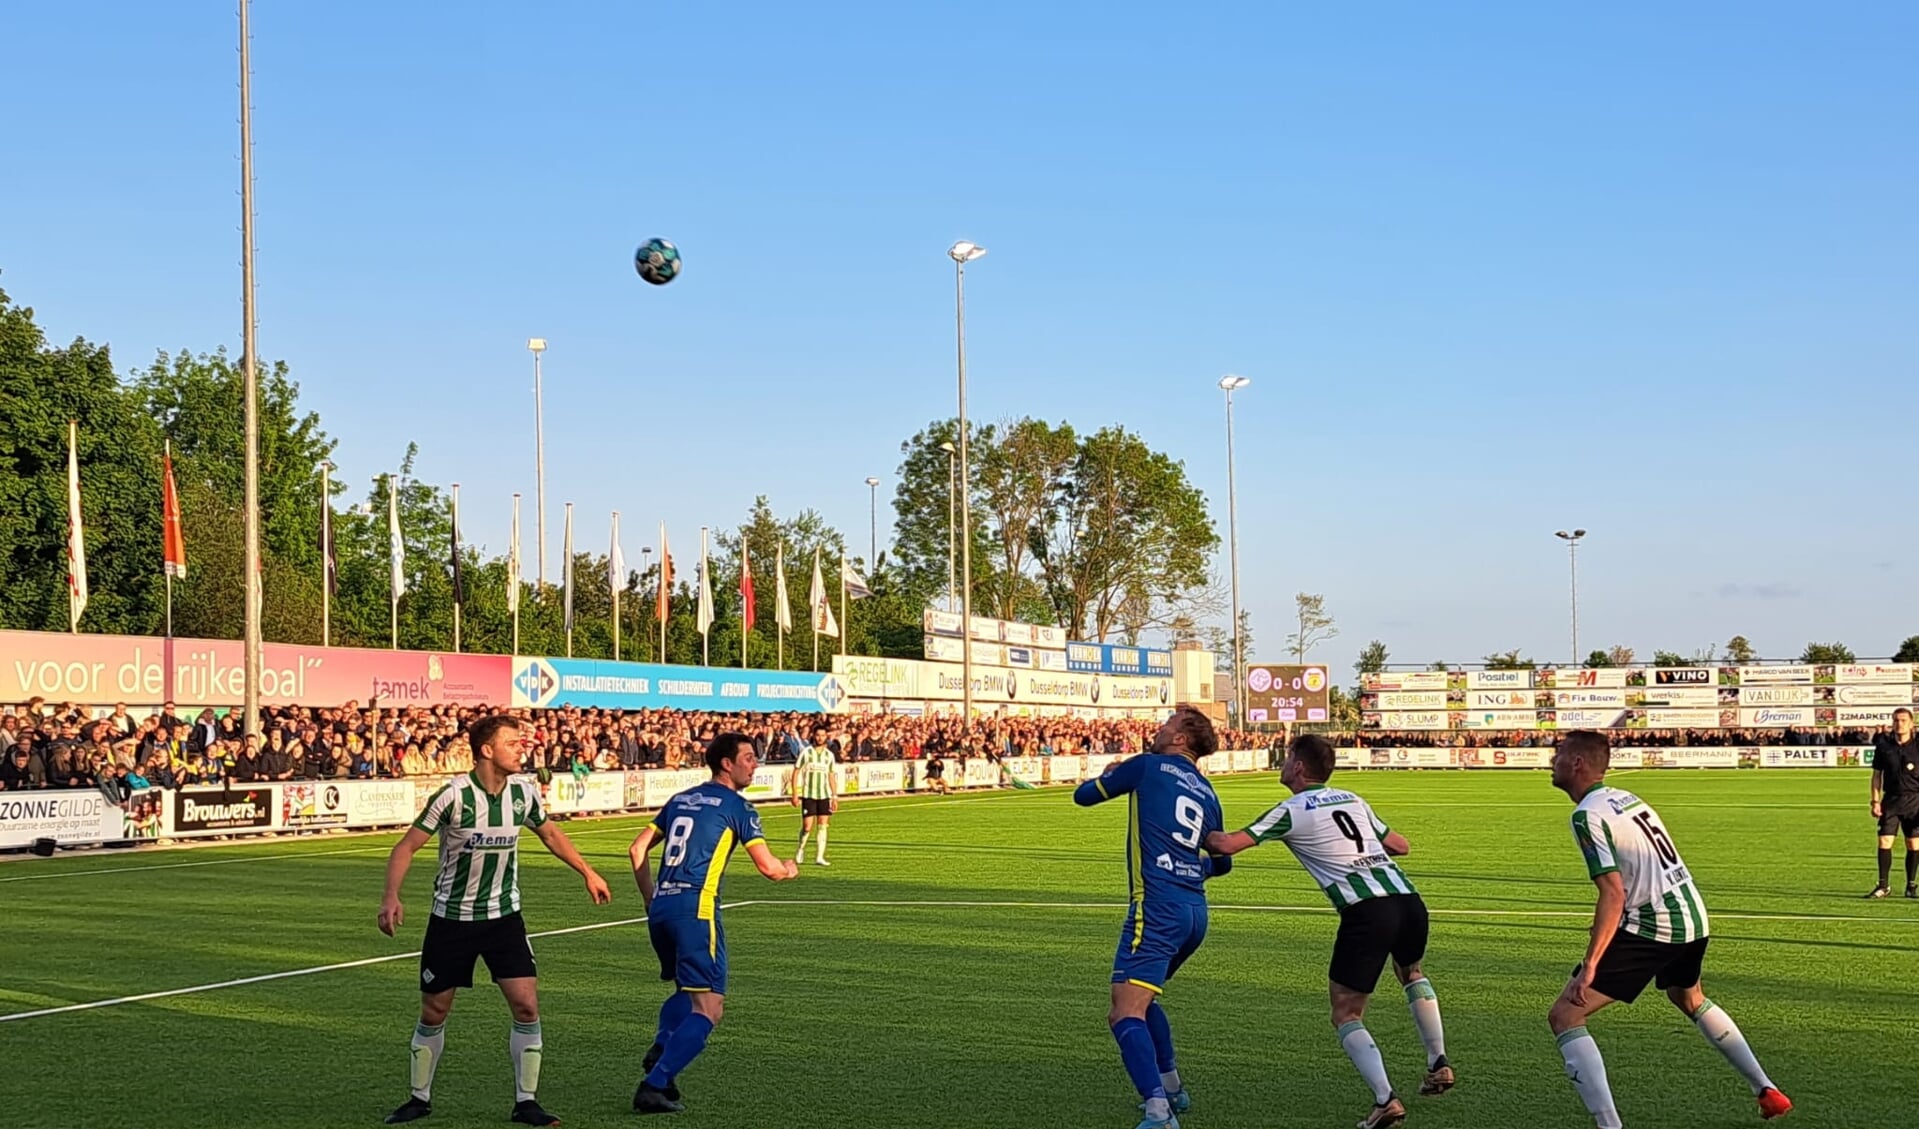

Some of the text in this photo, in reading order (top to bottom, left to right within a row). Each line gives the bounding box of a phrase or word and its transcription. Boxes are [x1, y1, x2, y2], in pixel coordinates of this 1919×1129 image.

[15, 659, 107, 694] voor
[117, 647, 163, 694] de
[177, 650, 245, 700] rijke
[519, 675, 548, 689] VDK
[859, 662, 909, 684] REGELINK
[1672, 671, 1708, 680] VINO
[372, 676, 430, 700] tamek
[562, 675, 649, 694] INSTALLATIETECHNIEK
[657, 679, 713, 696] SCHILDERWERK
[720, 682, 750, 698] AFBOUW
[984, 675, 1004, 693] BMW
[1030, 678, 1088, 697] Dusseldorp BMW
[1113, 684, 1159, 701] Dusseldorp BMW
[1273, 677, 1283, 690] 0
[1292, 677, 1302, 690] 0
[1271, 697, 1304, 708] 20:54
[1478, 694, 1506, 705] ING
[1571, 694, 1617, 702] Fix Bouw
[1406, 714, 1439, 724] SLUMP
[1784, 749, 1827, 759] PALET
[0, 799, 102, 820] ZONNEGILDE
[40, 820, 69, 831] energie
[70, 820, 80, 829] op
[1171, 795, 1204, 849] 9
[1331, 810, 1365, 853] 9
[1632, 810, 1678, 870] 15
[665, 817, 694, 867] 8
